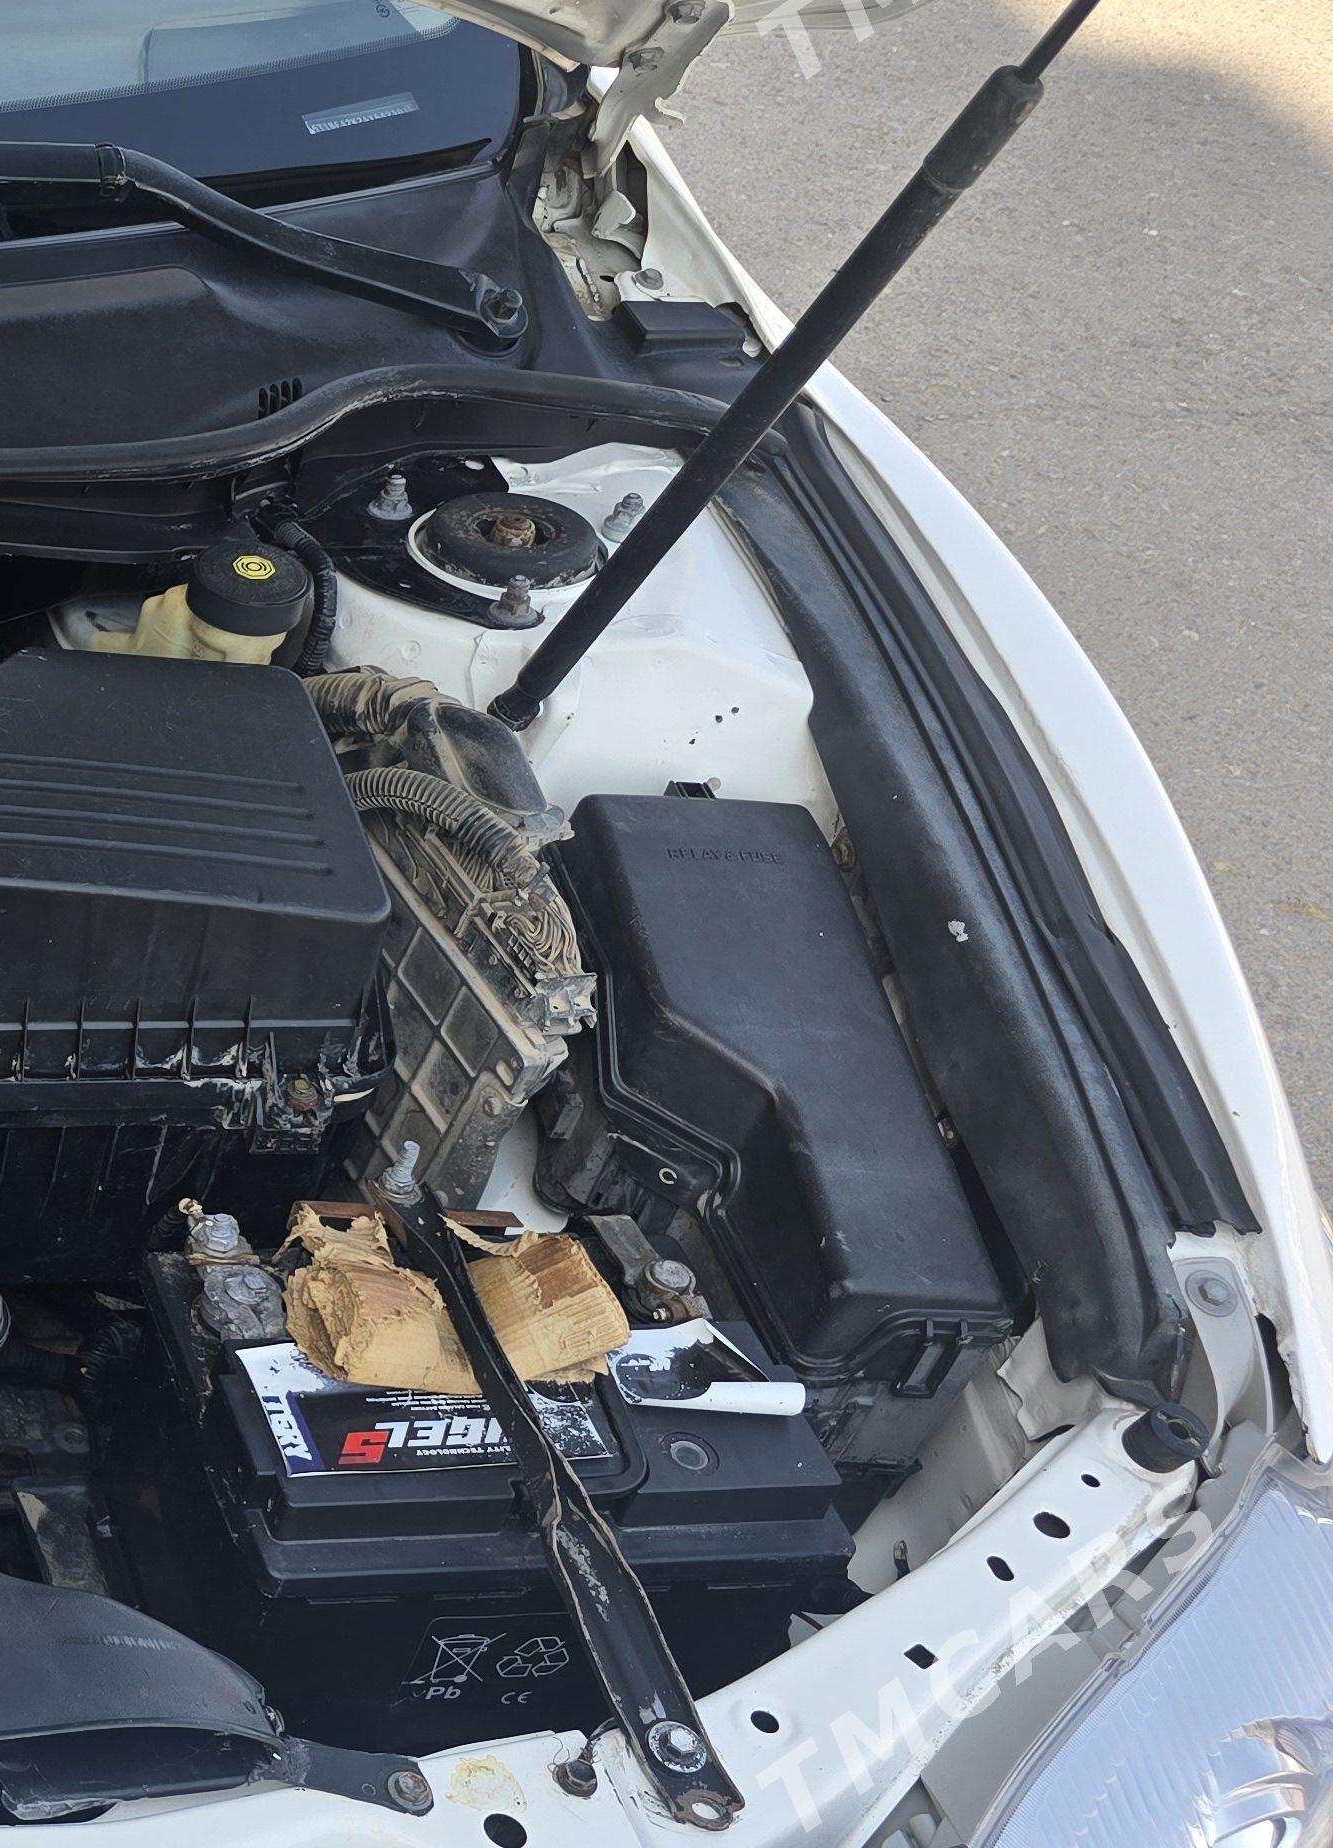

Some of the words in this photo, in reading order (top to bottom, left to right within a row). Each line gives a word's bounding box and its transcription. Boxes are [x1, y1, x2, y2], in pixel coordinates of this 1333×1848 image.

[667, 847, 720, 861] RELAY
[738, 850, 783, 864] FUSE
[425, 1686, 461, 1700] Pb
